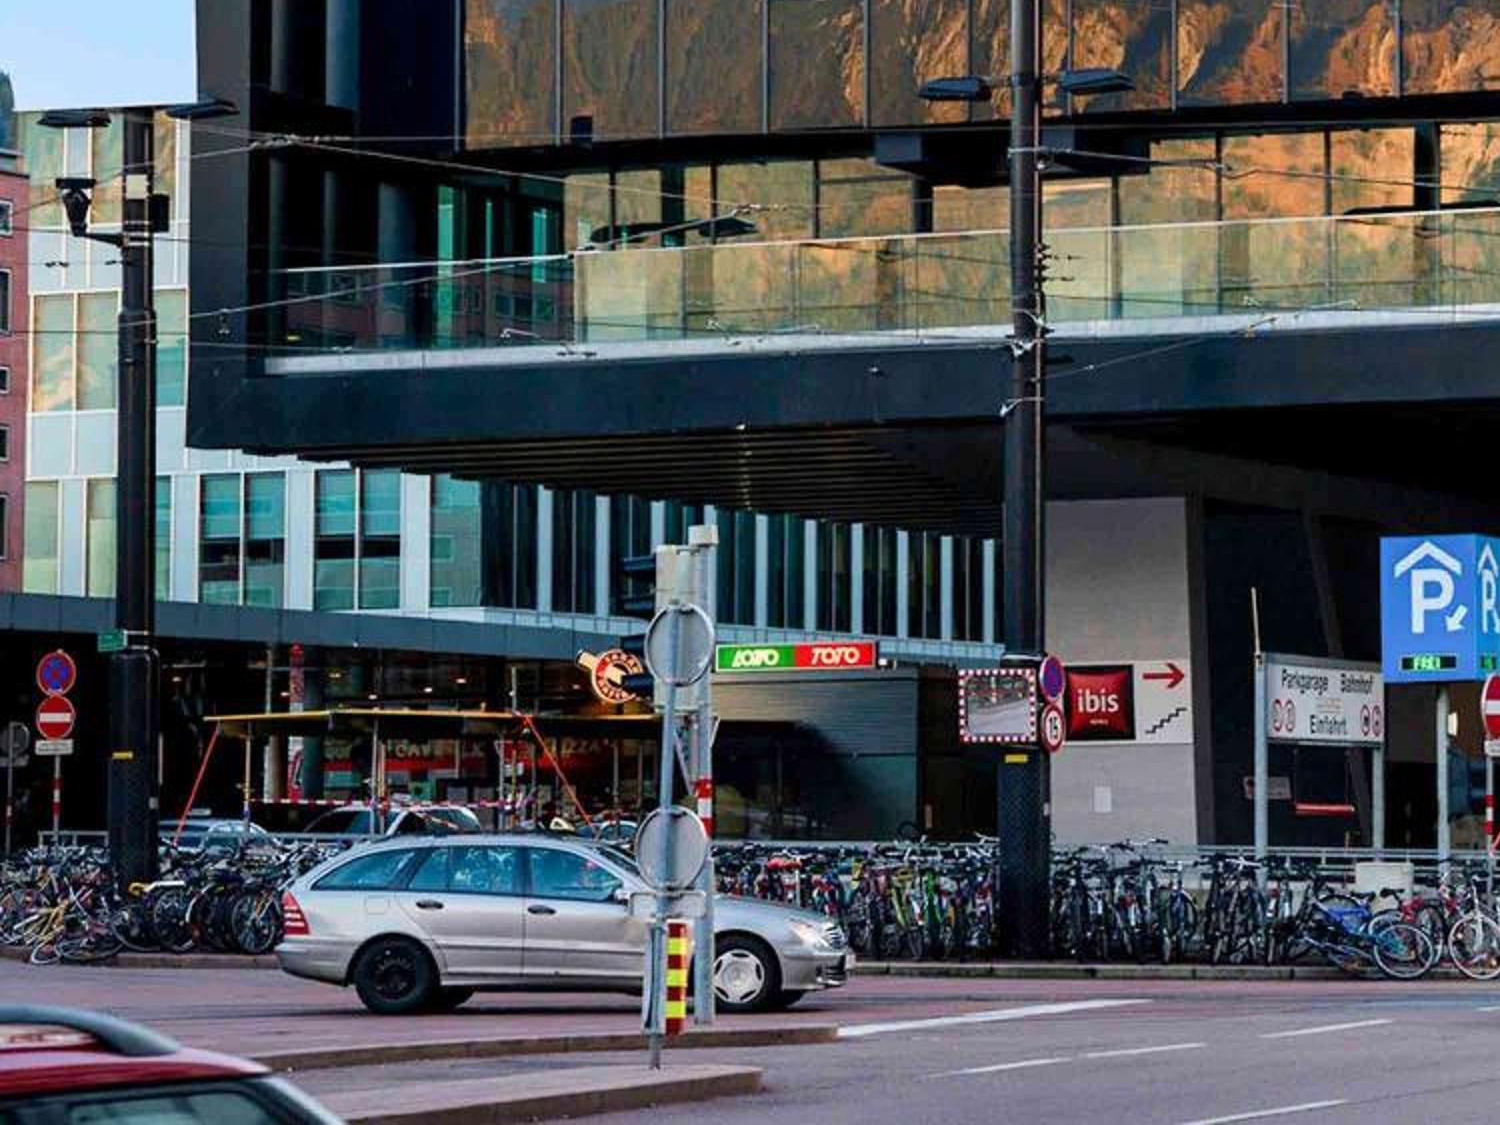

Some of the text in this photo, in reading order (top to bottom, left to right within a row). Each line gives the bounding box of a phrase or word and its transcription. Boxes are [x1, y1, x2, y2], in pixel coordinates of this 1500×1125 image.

[1411, 568, 1454, 634] P
[731, 647, 779, 668] LOTTO
[811, 646, 861, 667] TOTO
[1281, 667, 1375, 696] Parkgarage Bahnhof
[1077, 687, 1120, 714] ibis
[1310, 714, 1348, 735] Einfahrt
